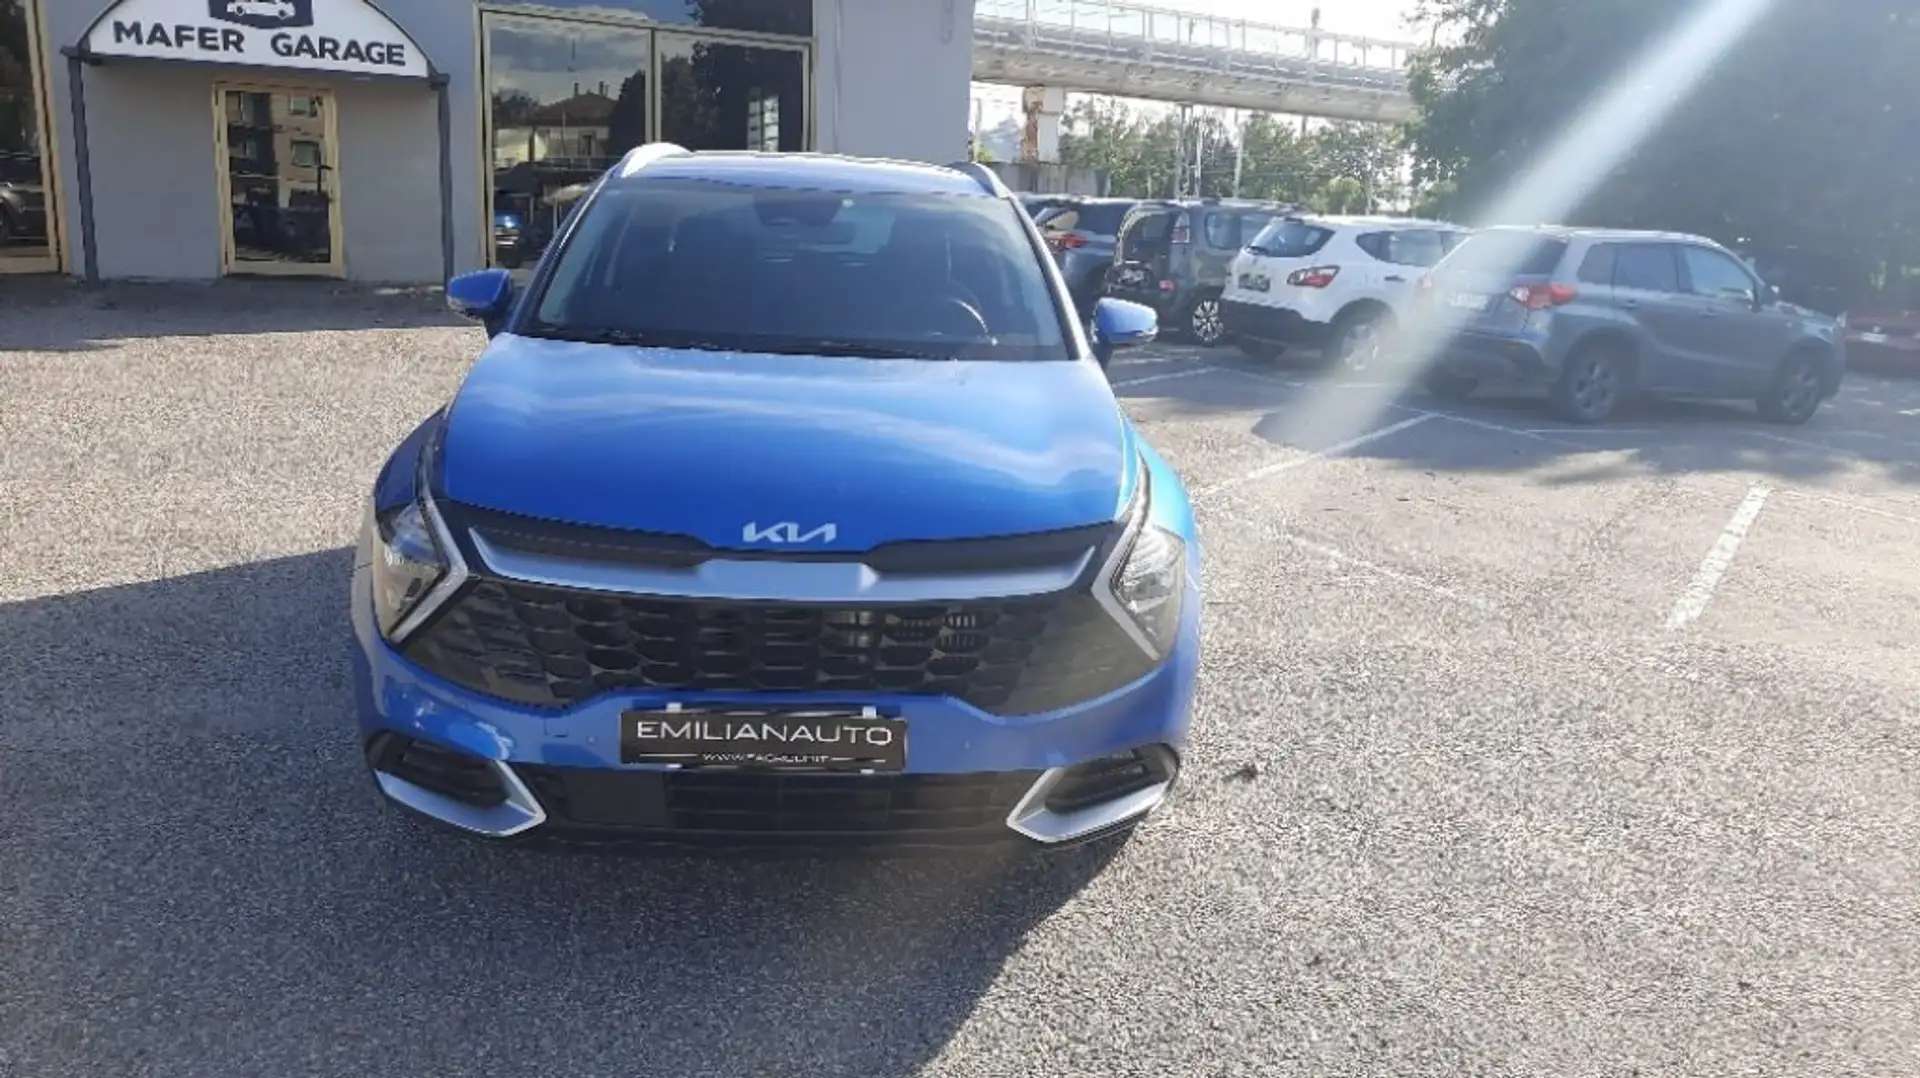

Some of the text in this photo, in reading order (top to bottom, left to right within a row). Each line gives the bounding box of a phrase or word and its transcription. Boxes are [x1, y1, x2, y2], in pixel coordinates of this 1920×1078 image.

[113, 21, 406, 66] MAFER GARAGE
[637, 721, 893, 746] EMILIANAUTO
